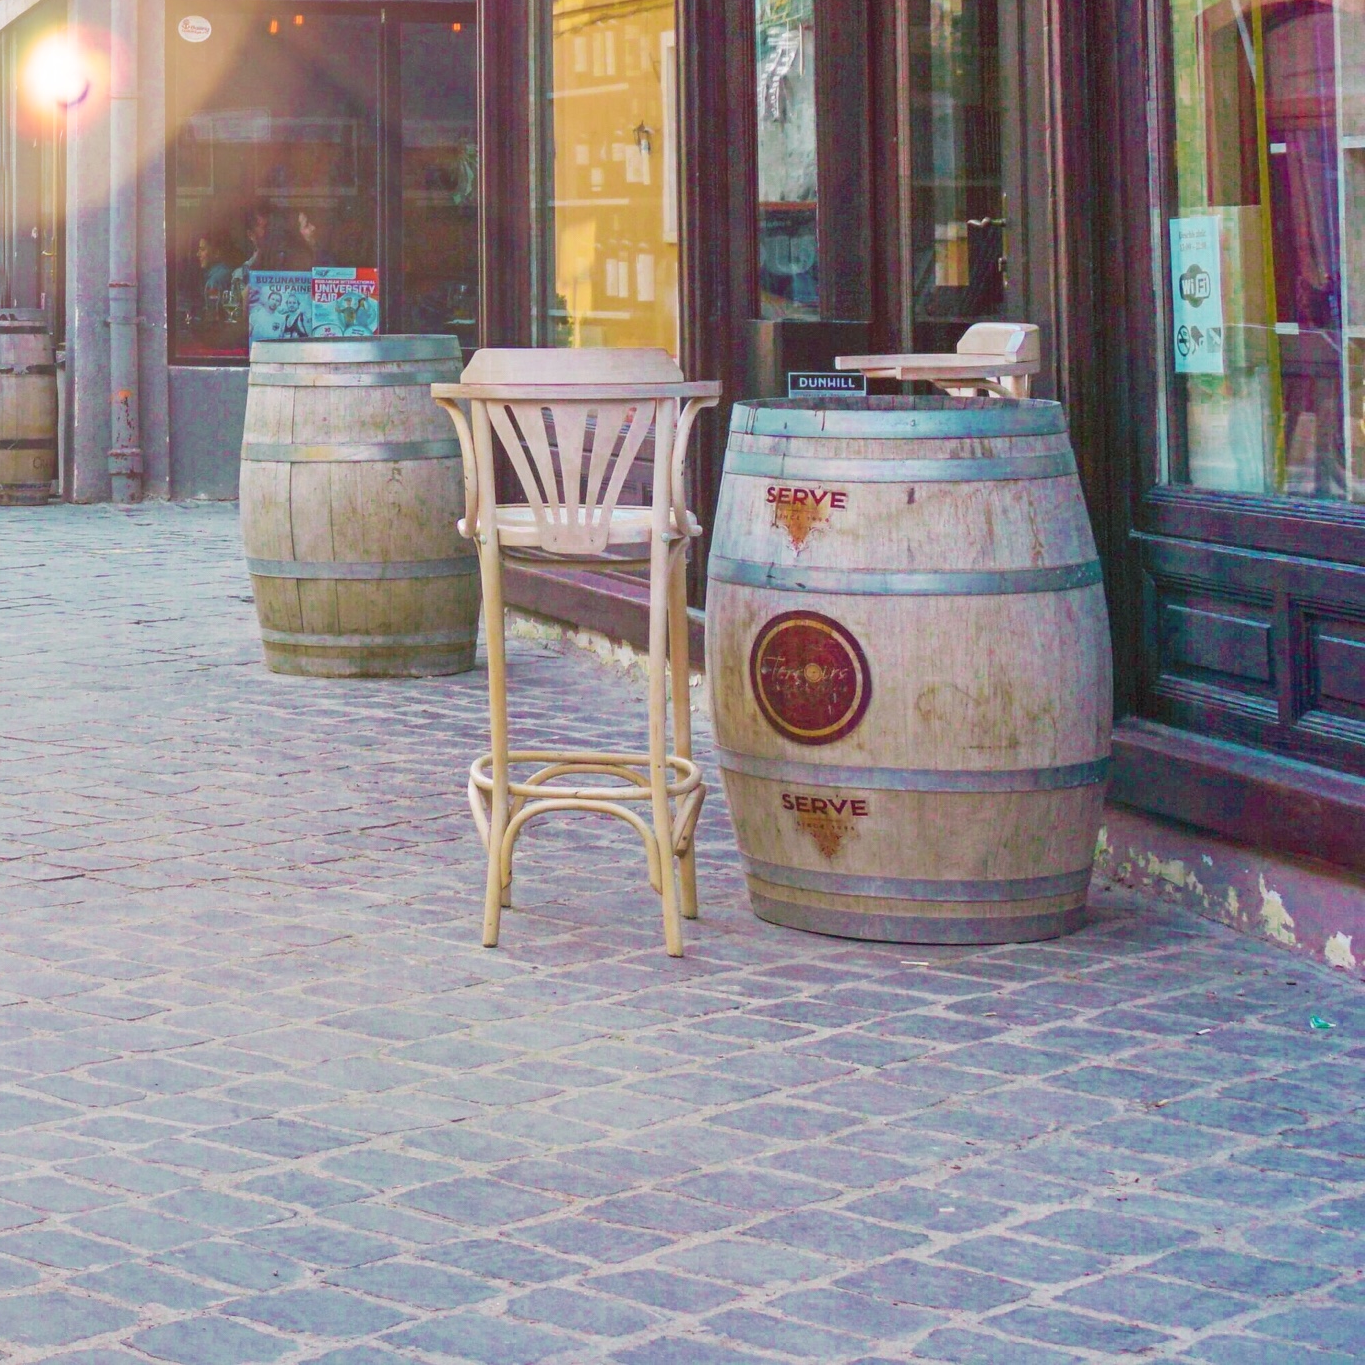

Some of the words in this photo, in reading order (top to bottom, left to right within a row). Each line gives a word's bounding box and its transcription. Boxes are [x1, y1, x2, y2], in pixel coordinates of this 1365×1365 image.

[269, 284, 282, 293] CU
[314, 284, 376, 295] UNIVERSITY
[314, 292, 338, 303] FAIR
[799, 377, 856, 388] DUNHILL
[766, 486, 848, 510] SERVE
[781, 794, 869, 817] SERVE
